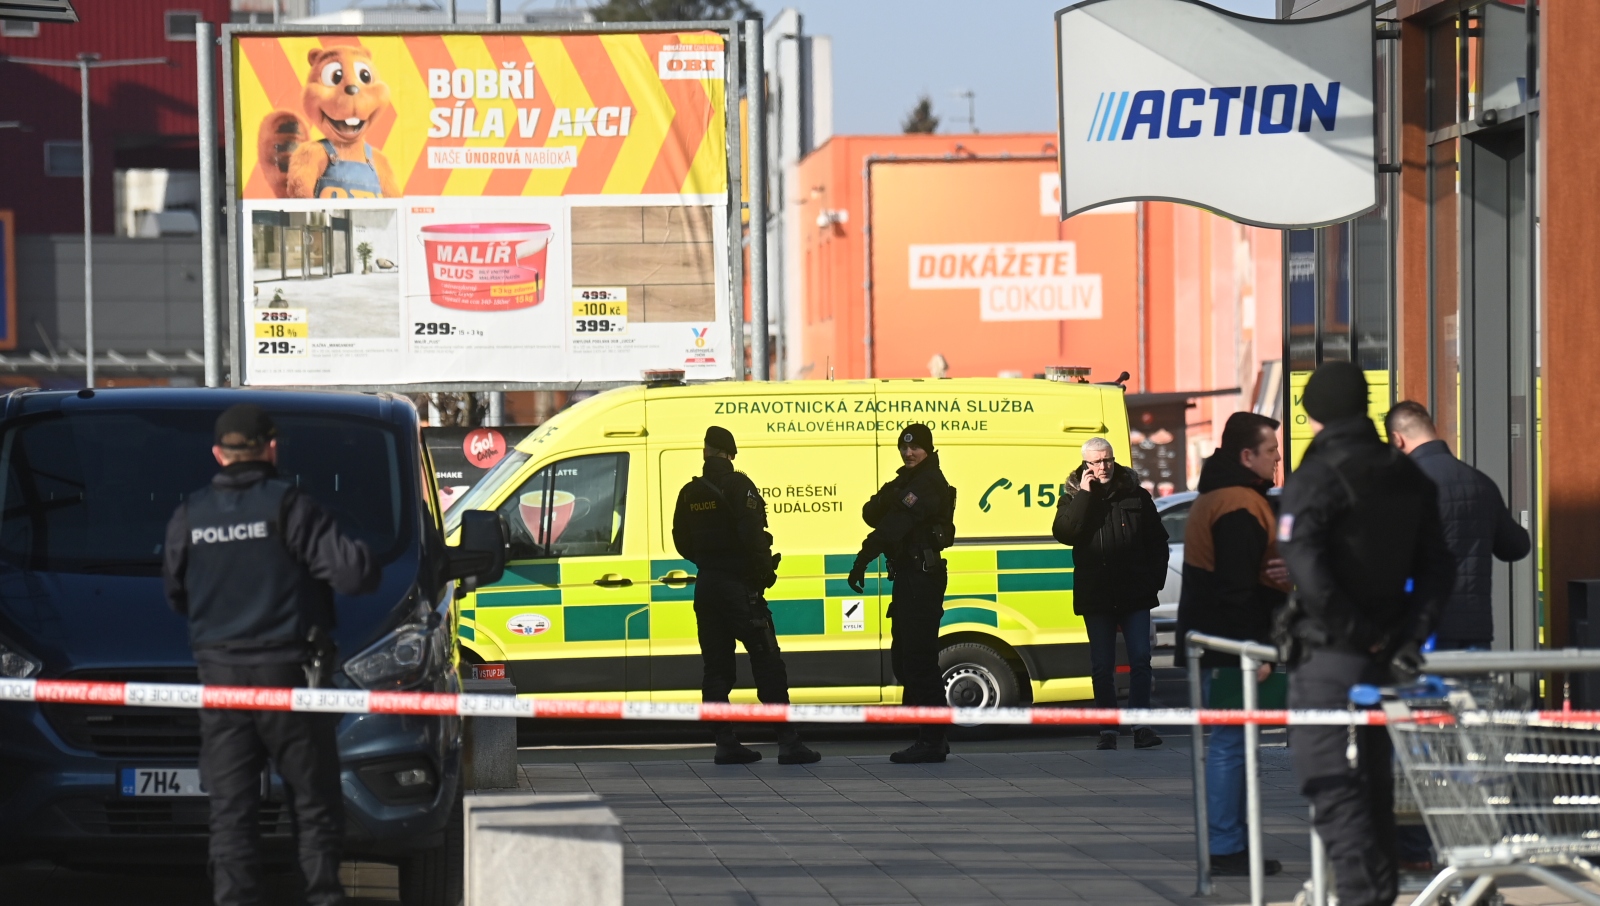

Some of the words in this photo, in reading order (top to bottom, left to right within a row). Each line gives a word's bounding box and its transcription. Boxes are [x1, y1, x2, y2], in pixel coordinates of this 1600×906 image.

[666, 59, 715, 71] OBI
[428, 62, 535, 99] BOBŘÍ
[1121, 81, 1341, 141] ACTION
[428, 101, 505, 138] SÍLA
[517, 107, 541, 138] V
[548, 106, 631, 138] AKCI
[434, 150, 461, 164] NAŠE
[465, 149, 521, 164] ÚNOROVÁ
[525, 149, 571, 165] NABÍDKA
[436, 240, 511, 264] MALÍŘ
[918, 248, 1069, 279] DOKÁŽETE
[440, 267, 474, 280] PLUS
[989, 285, 1095, 312] COKOLIV
[578, 303, 607, 316] -100
[610, 306, 621, 315] Kč
[264, 324, 284, 337] -18
[714, 398, 848, 415] ZDRAVOTNICKÁ
[854, 397, 961, 414] ZÁCHRANNÁ
[966, 397, 1034, 414] SLUŽBA
[941, 420, 988, 431] KRAJE
[470, 432, 494, 455] Go!
[786, 484, 837, 498] ŘEŠENÍ
[690, 500, 717, 512] POLICIE
[774, 500, 843, 514] UDÁLOSTI
[191, 521, 267, 545] POLICIE
[479, 669, 497, 678] VSTUP
[88, 685, 122, 701] VSTUP
[128, 689, 145, 705] ČR
[150, 689, 199, 703] POLICIE
[256, 689, 290, 706] VSTUP
[317, 694, 364, 708] POLICIE
[295, 694, 312, 710] ČR
[421, 694, 456, 710] VSTUP
[140, 771, 181, 793] 7H4
